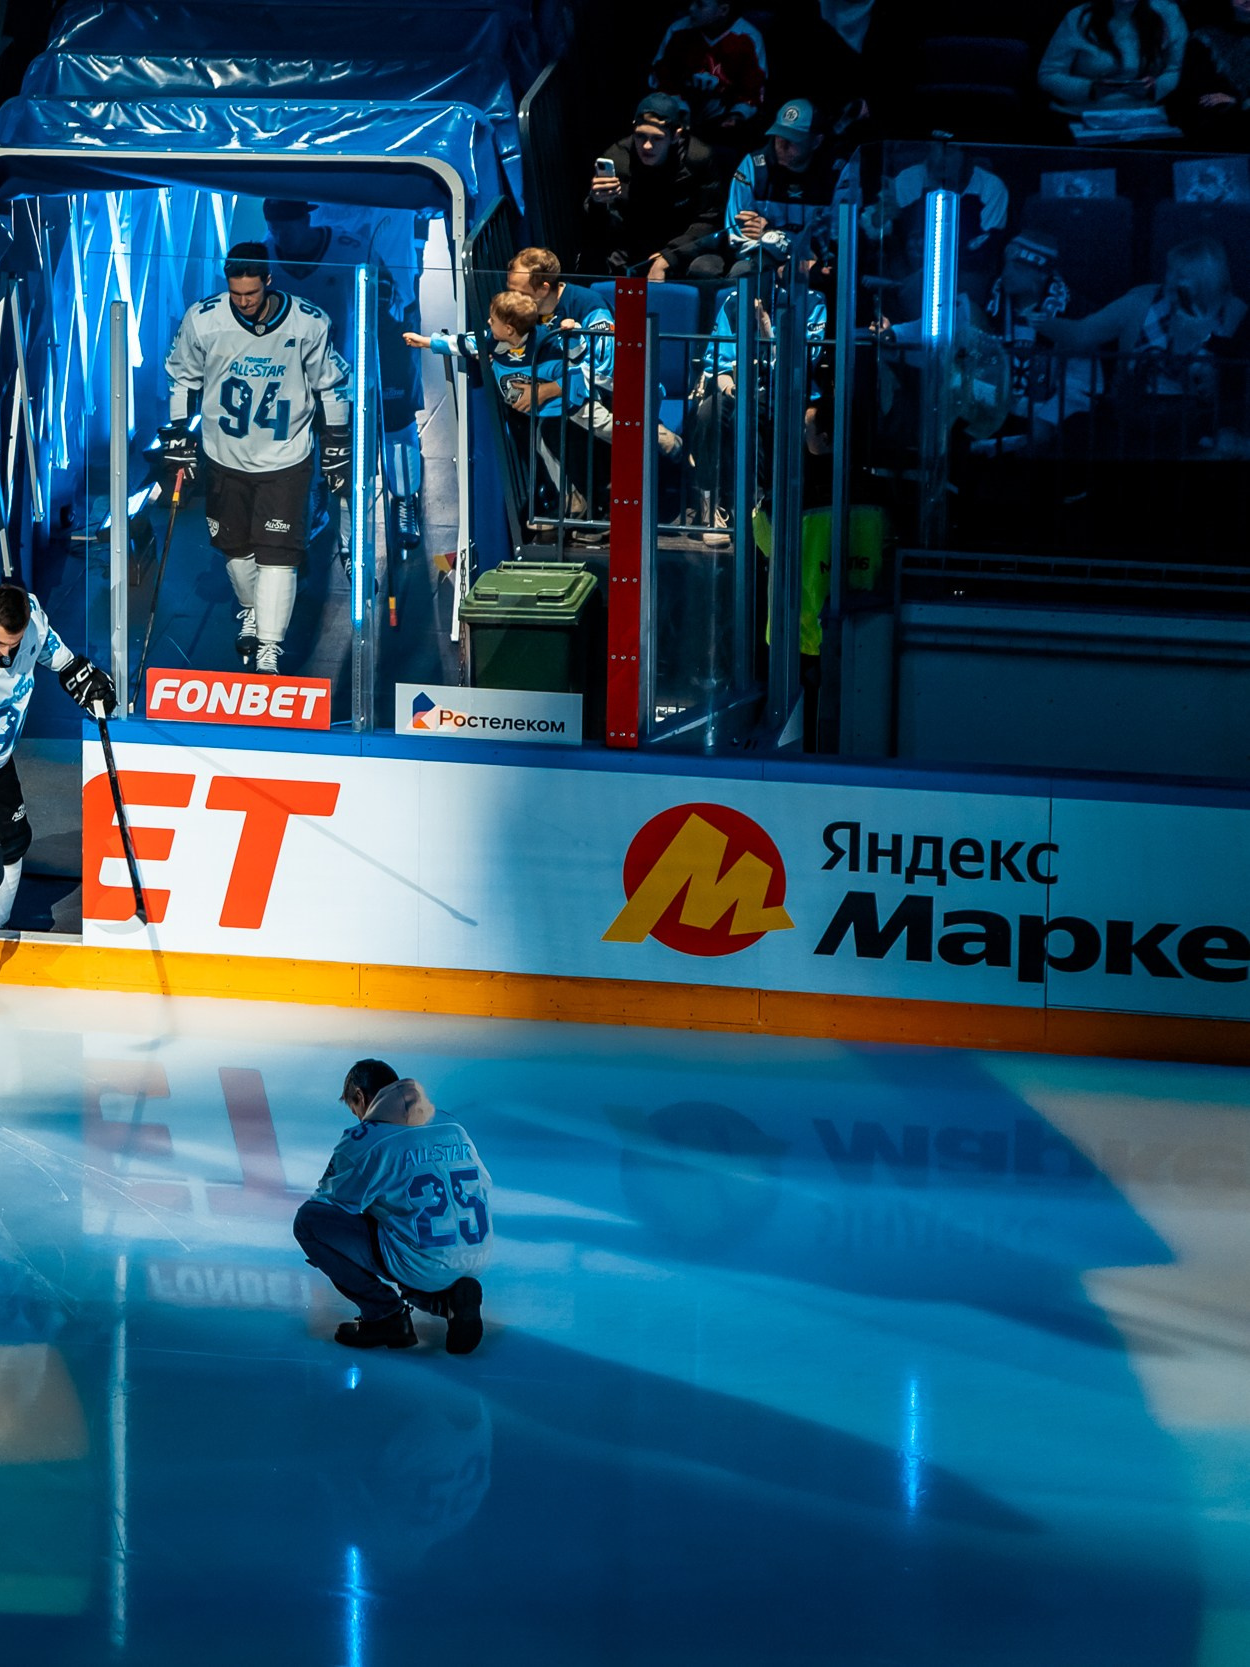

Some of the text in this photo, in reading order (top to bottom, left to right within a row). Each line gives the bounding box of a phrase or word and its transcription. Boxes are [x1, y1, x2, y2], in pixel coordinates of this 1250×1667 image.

[218, 376, 291, 441] 94
[325, 447, 352, 456] CC
[149, 678, 327, 720] FONBET
[439, 709, 565, 734] Ростелеком
[821, 821, 1060, 886] Яндекс
[407, 1168, 490, 1249] 25
